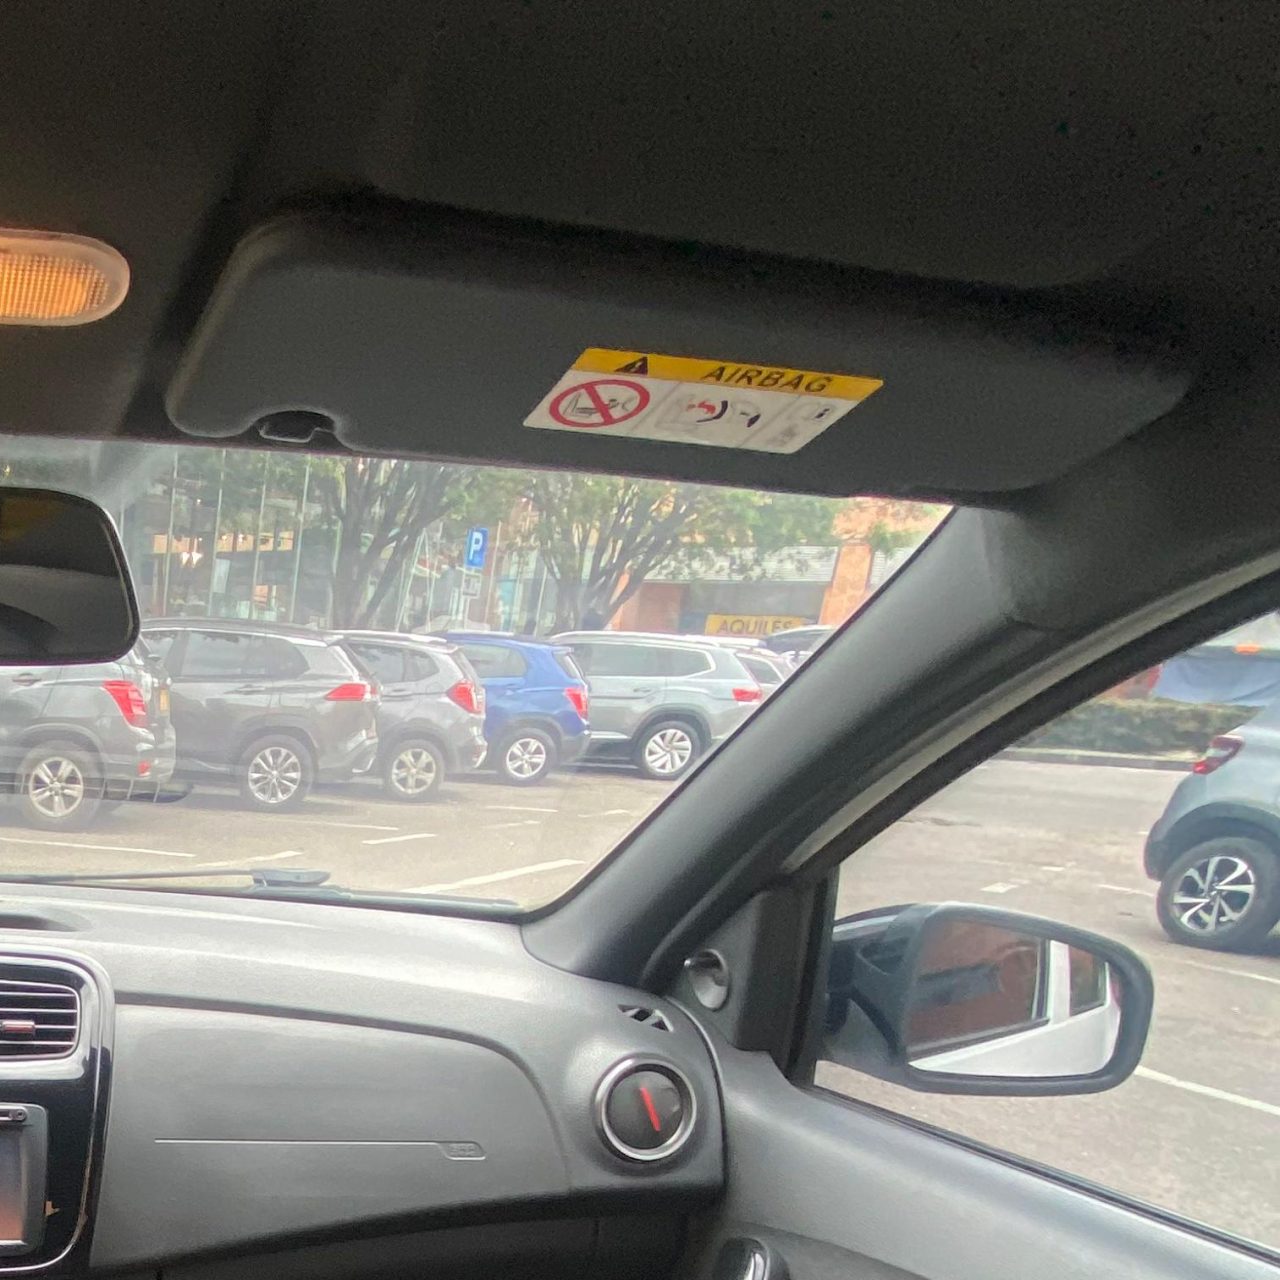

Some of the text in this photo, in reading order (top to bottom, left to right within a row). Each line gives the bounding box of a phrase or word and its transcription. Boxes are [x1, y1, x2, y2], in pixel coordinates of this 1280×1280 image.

[703, 364, 835, 394] AIRBAG
[469, 531, 483, 560] P
[717, 619, 793, 635] AQUILES
